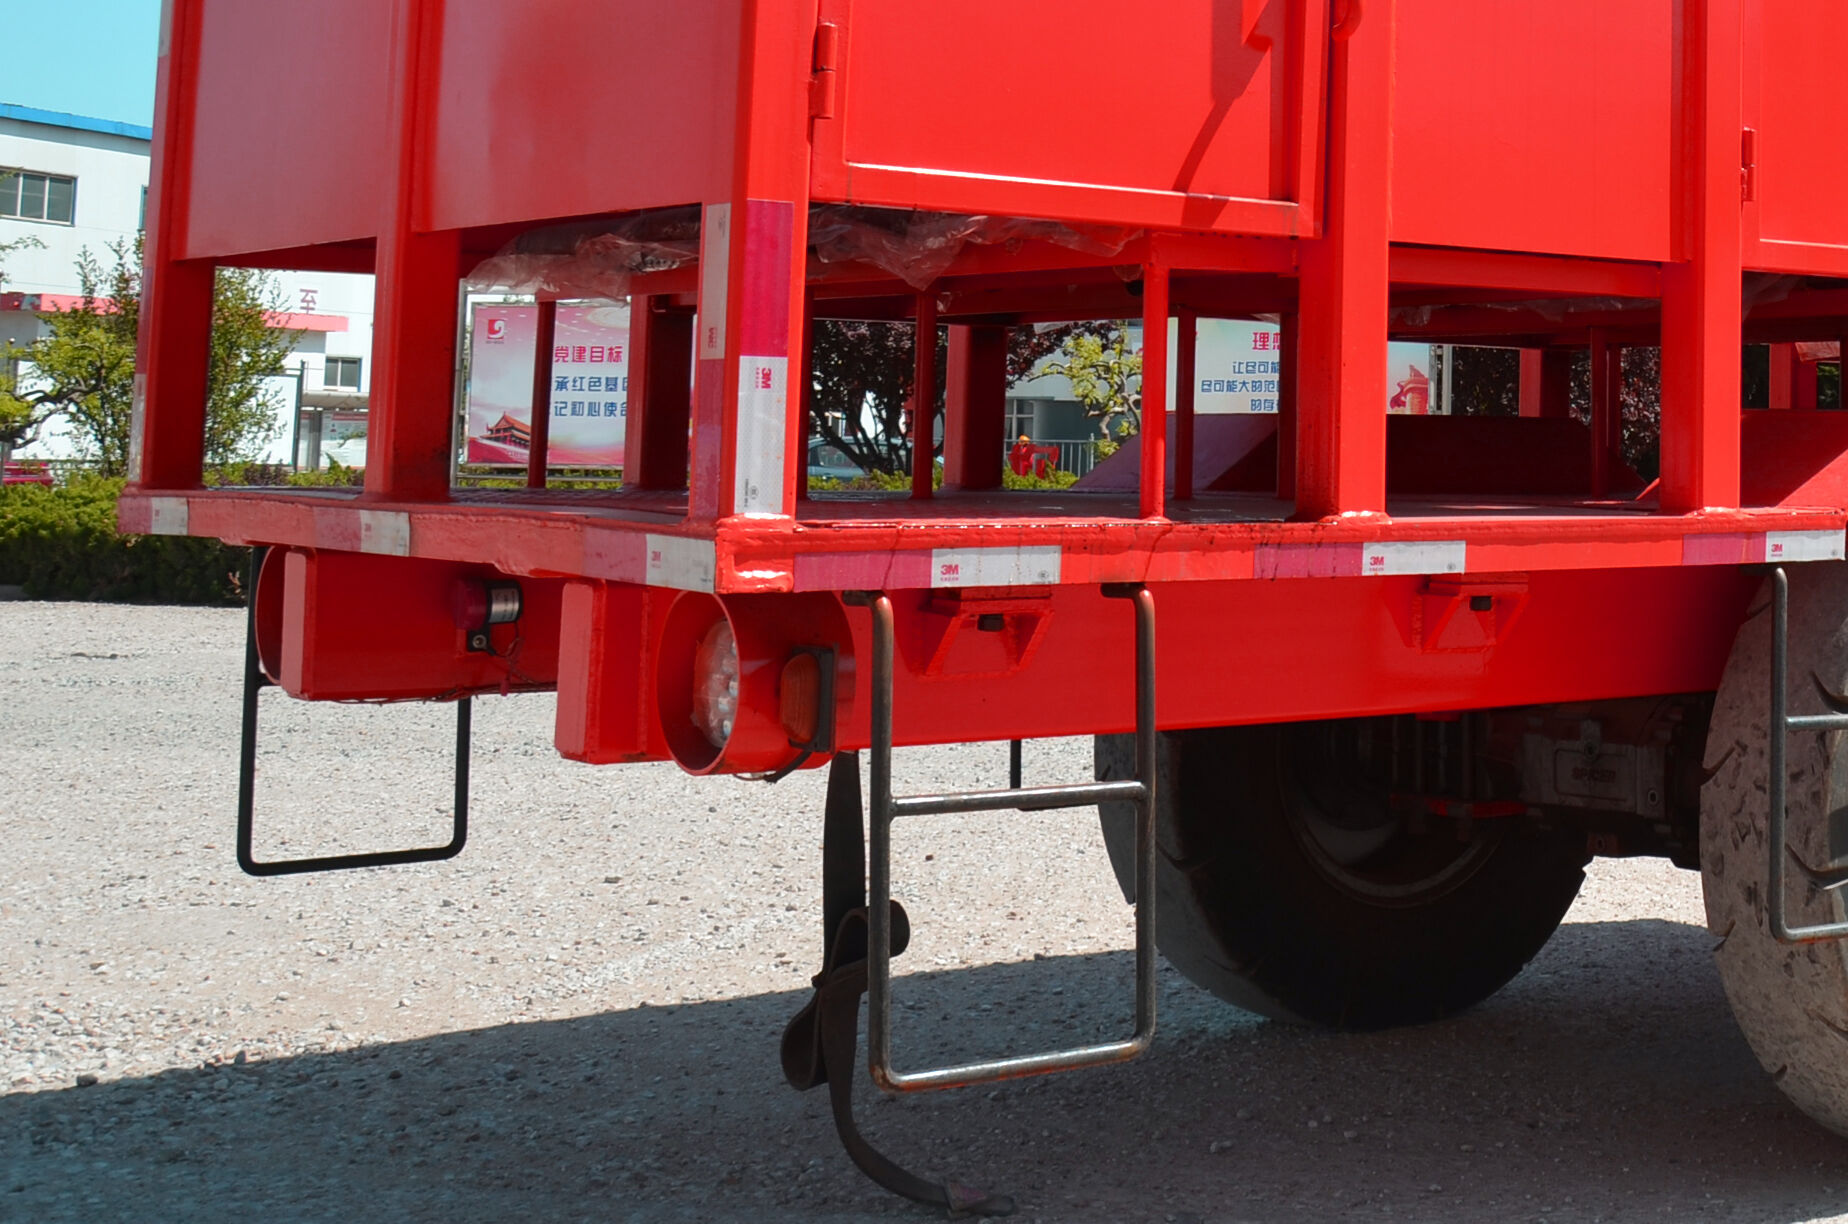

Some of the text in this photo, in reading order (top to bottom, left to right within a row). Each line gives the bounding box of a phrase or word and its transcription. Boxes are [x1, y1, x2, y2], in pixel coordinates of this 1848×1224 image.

[554, 345, 623, 362] 党建目标
[761, 367, 772, 389] 3M
[1201, 380, 1279, 392] 尽可能大的范
[1250, 399, 1279, 411] 的存
[1770, 543, 1783, 553] 3M
[1369, 556, 1385, 566] 3M
[940, 564, 959, 575] 3M
